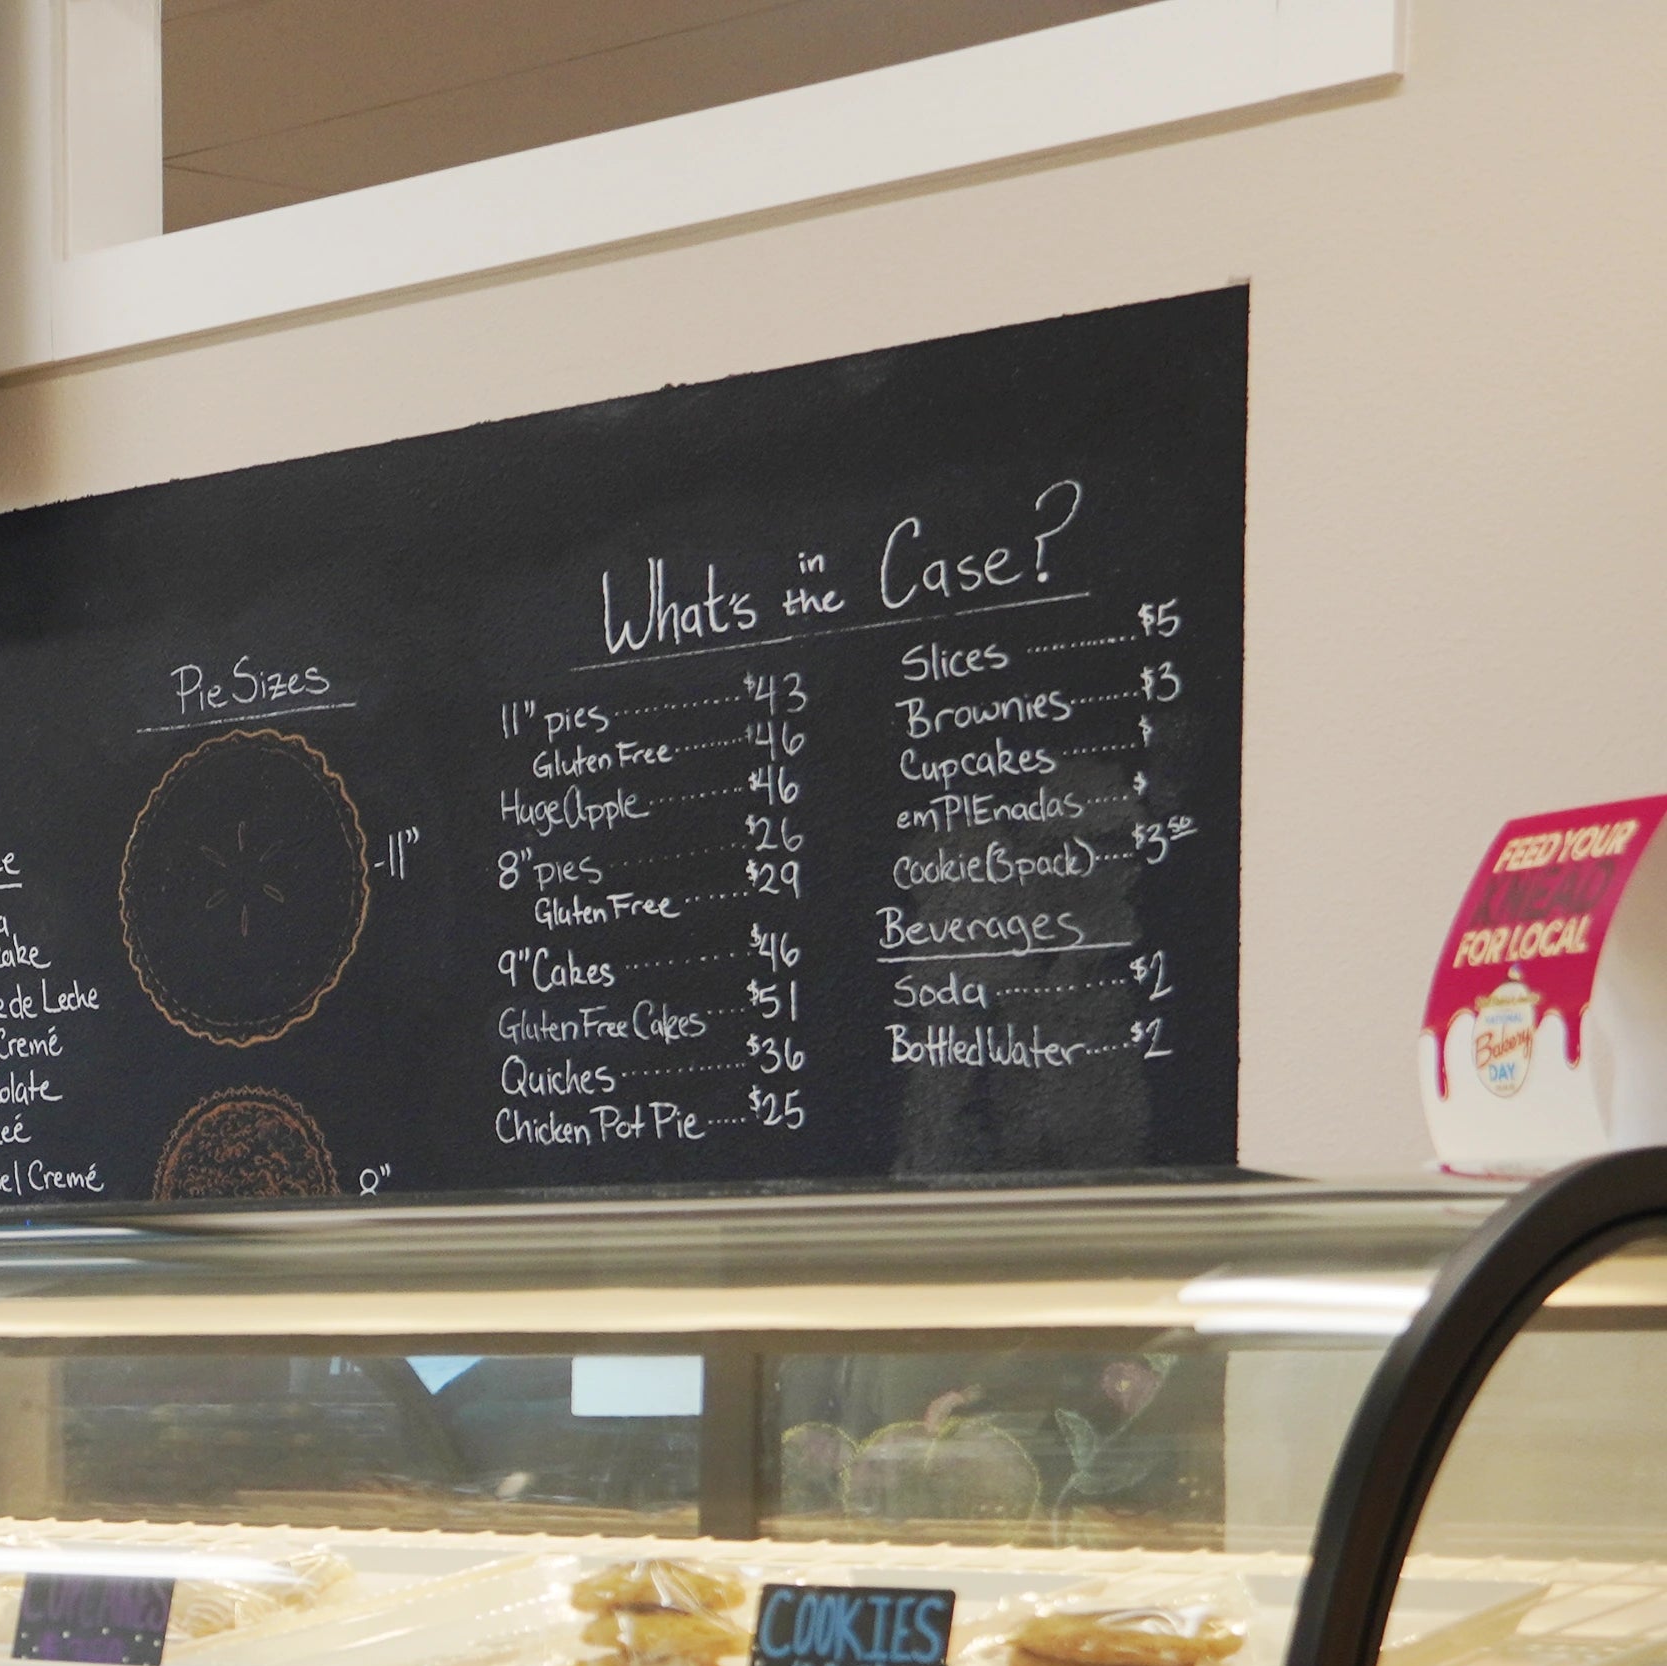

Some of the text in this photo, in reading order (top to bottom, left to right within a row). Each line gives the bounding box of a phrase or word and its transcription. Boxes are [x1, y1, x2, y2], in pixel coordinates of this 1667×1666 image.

[602, 479, 1083, 654] What's in the Case?
[902, 600, 1181, 682] Slices $5
[171, 656, 330, 714] Pie Sizes
[544, 672, 807, 742] pies $43
[896, 661, 1182, 740] Brownies $3
[533, 741, 674, 780] Gluten Free
[900, 738, 1057, 791] Cupcakes
[500, 765, 799, 836] Huge $46
[533, 815, 804, 890] pies $26
[1493, 819, 1640, 873] FEED YOUR
[534, 859, 800, 929] Gluten Free $29
[532, 924, 800, 992] Cakes $46
[877, 907, 1085, 956] Beverages
[1452, 914, 1594, 969] FOR LOCAL
[8, 983, 38, 1020] de
[42, 979, 100, 1014] Leche
[893, 950, 1173, 1007] Soda $2
[499, 980, 797, 1044] Gluten Free Cakes $51
[1131, 1018, 1173, 1060] $2
[502, 1035, 804, 1097] Quiches $36
[1476, 1023, 1532, 1069] Bakery
[1489, 1062, 1515, 1082] DAY
[495, 1086, 805, 1145] Chicken Pot Pie $25
[28, 1159, 105, 1192] Cremé
[759, 1587, 947, 1664] COOKIES
